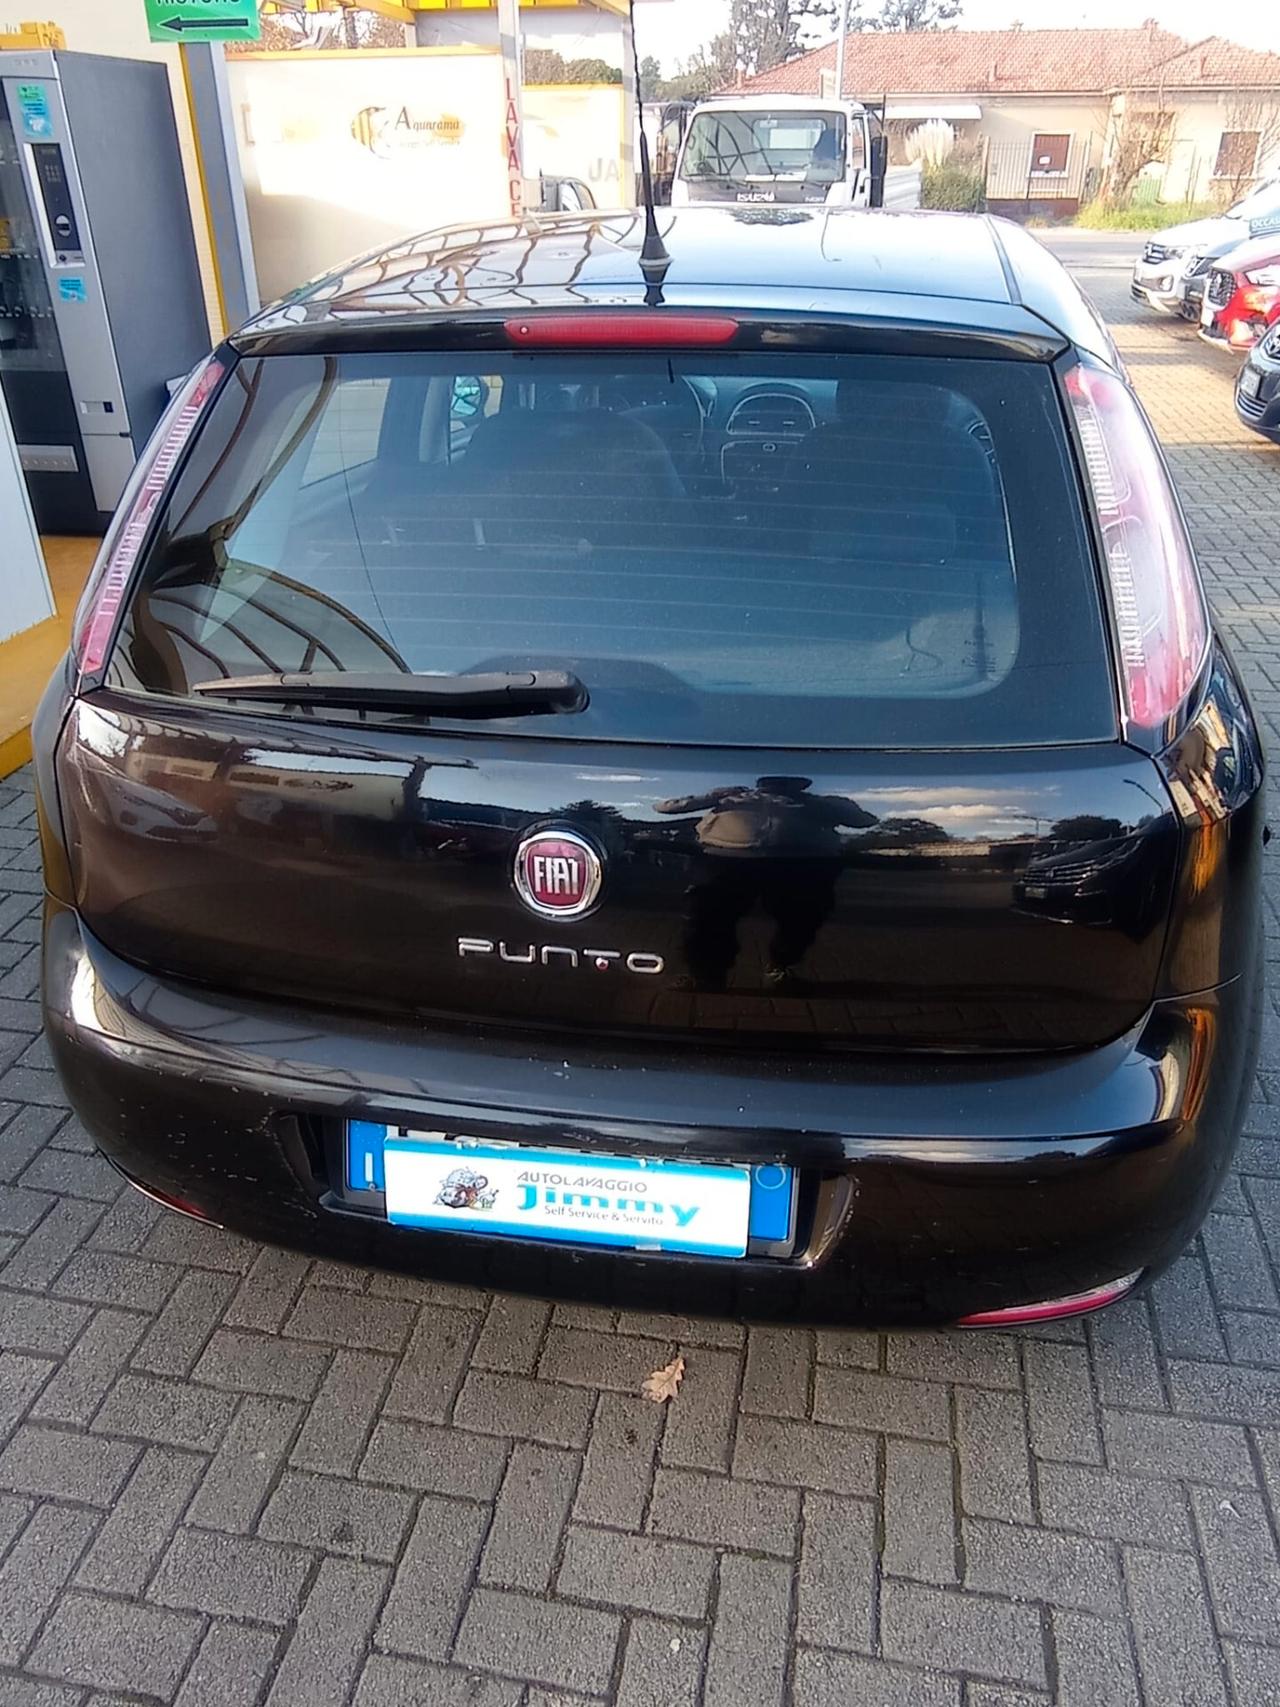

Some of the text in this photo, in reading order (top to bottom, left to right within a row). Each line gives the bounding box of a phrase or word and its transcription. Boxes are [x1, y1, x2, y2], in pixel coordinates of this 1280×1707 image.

[533, 855, 580, 896] FIAT
[457, 936, 665, 975] PUNTO
[516, 1170, 648, 1194] AUTOLAVAGGIO
[516, 1184, 701, 1227] Jimmy
[544, 1205, 664, 1226] Self Service & Servito
